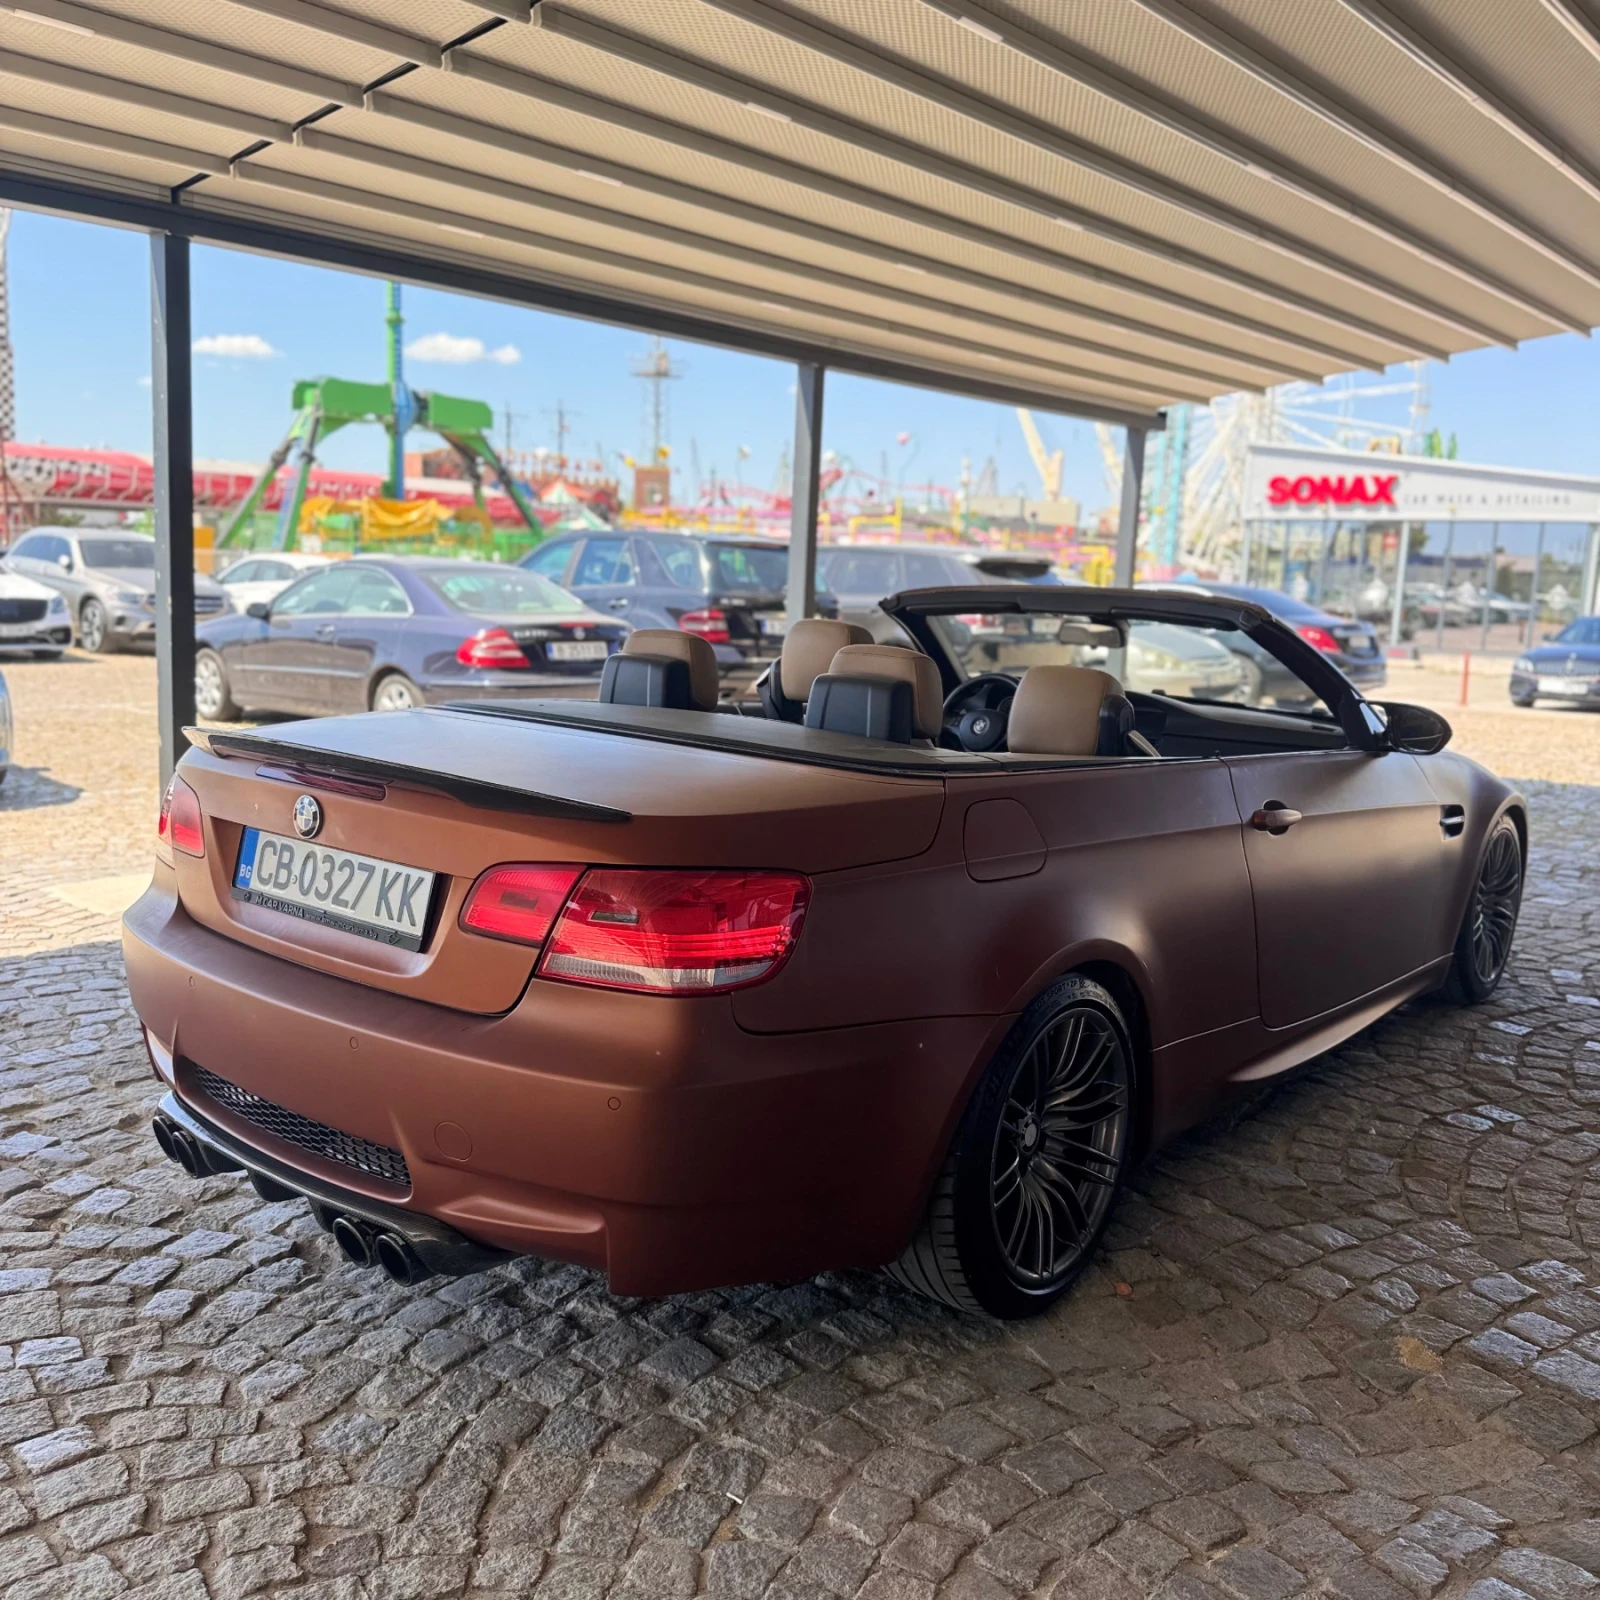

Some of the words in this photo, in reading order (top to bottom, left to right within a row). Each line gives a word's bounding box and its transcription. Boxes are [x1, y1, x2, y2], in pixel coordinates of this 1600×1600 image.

[1268, 475, 1398, 506] SONAX
[1403, 493, 1427, 505] CAR
[1497, 493, 1571, 506] DETAILING
[239, 864, 252, 879] BG
[262, 897, 278, 910] CAR
[278, 901, 305, 919] VARNA
